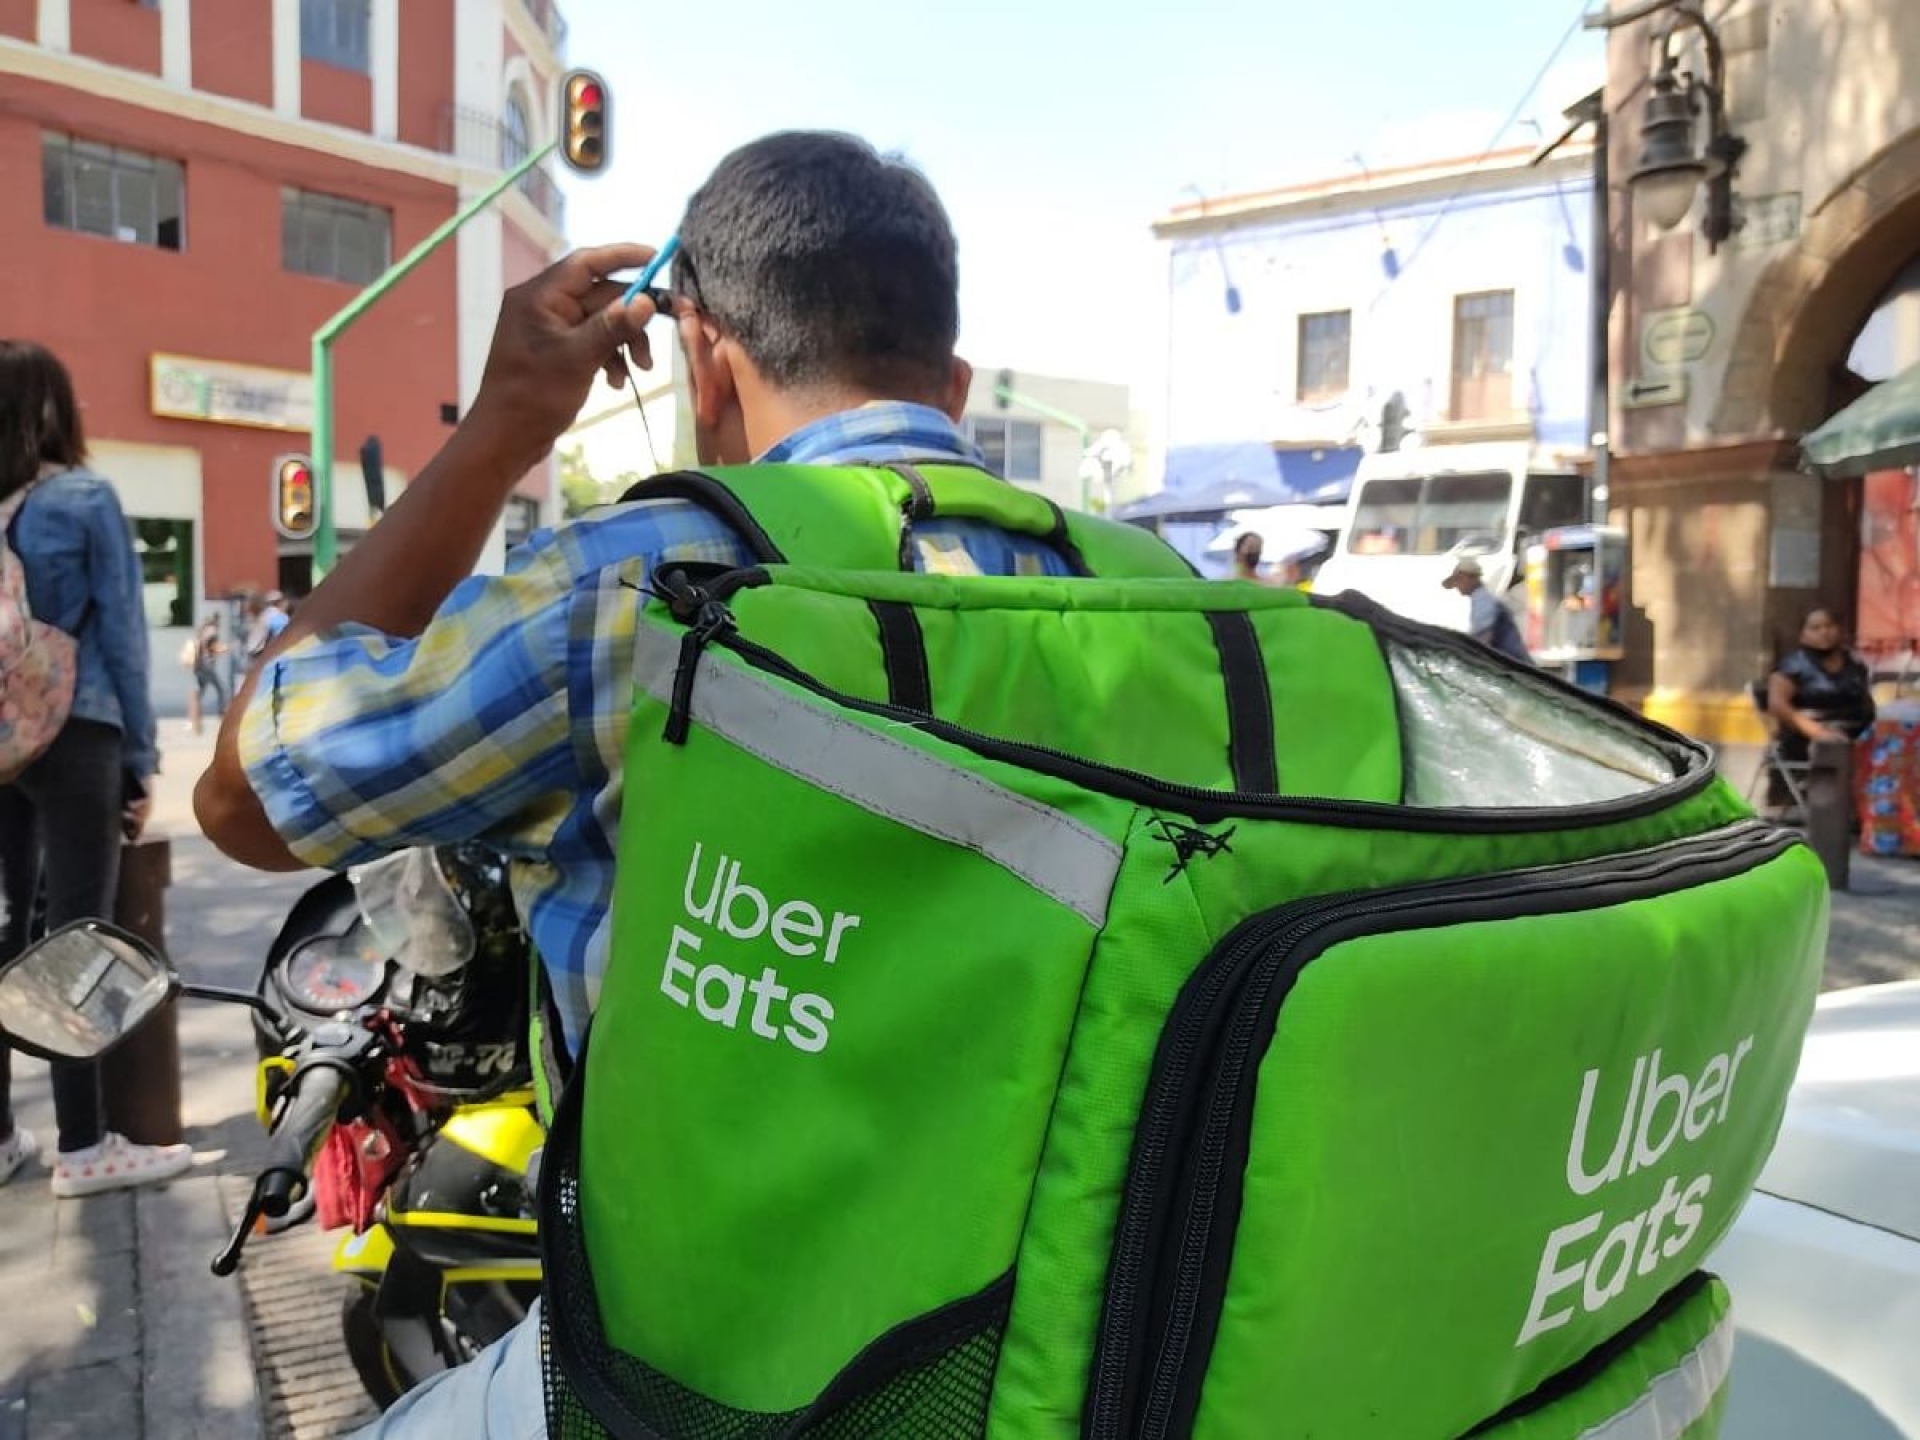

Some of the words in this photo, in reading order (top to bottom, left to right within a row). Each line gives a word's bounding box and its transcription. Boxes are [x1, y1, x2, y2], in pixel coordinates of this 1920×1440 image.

[684, 841, 861, 964] Uber
[660, 924, 835, 1053] Eats
[1566, 1034, 1754, 1196] Uber
[1514, 1173, 1713, 1347] Eats
